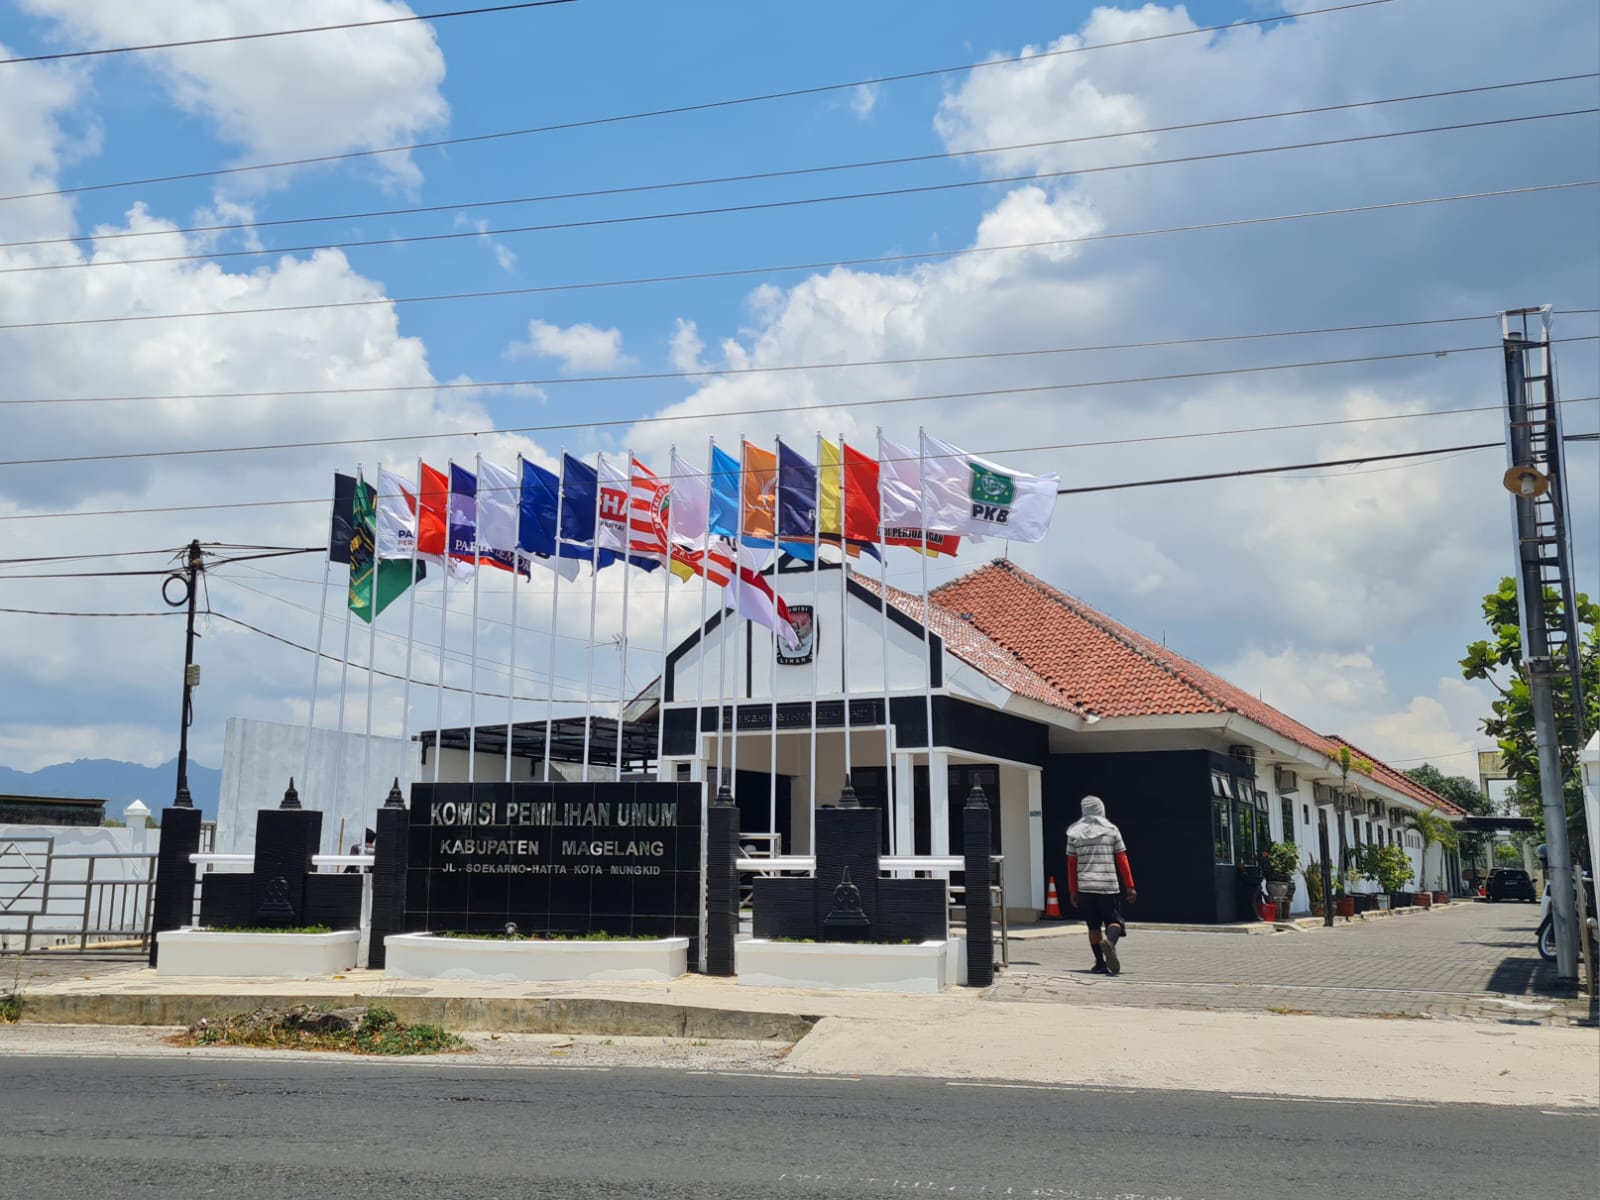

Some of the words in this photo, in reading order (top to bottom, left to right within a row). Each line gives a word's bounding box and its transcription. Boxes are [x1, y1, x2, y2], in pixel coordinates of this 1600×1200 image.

[972, 503, 1010, 523] PKB
[431, 802, 496, 826] KOMISI
[506, 802, 610, 827] PEMILIHAN
[617, 803, 677, 827] UMUM
[440, 839, 539, 855] KABUPATEN
[562, 840, 664, 856] MAGELANG
[442, 863, 462, 873] JL.
[465, 863, 567, 875] SOEKARNO-HATTA
[574, 864, 603, 875] KOTA
[610, 865, 661, 876] MUNGKID
